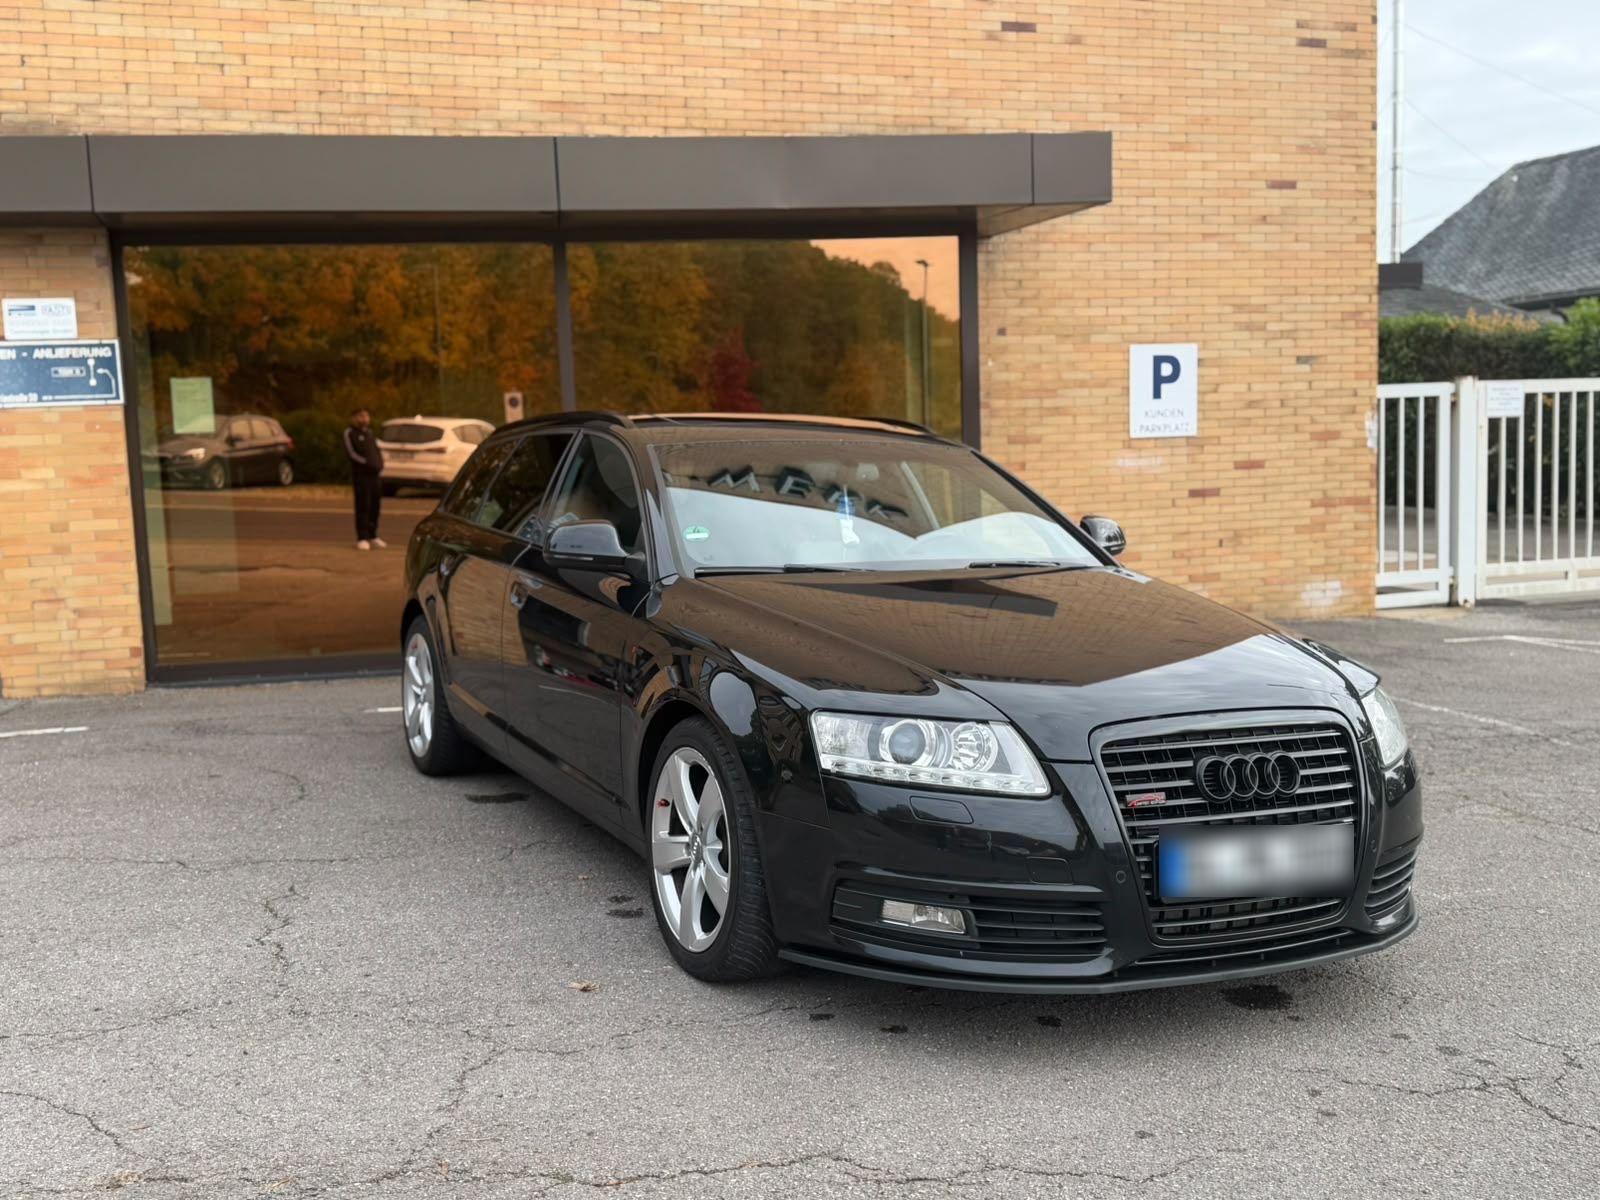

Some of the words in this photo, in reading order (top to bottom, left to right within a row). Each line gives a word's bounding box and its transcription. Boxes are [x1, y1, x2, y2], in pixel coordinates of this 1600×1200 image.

[33, 346, 112, 359] ANLIEFERUNG
[1153, 355, 1181, 399] P
[1144, 408, 1184, 418] KUNDEN
